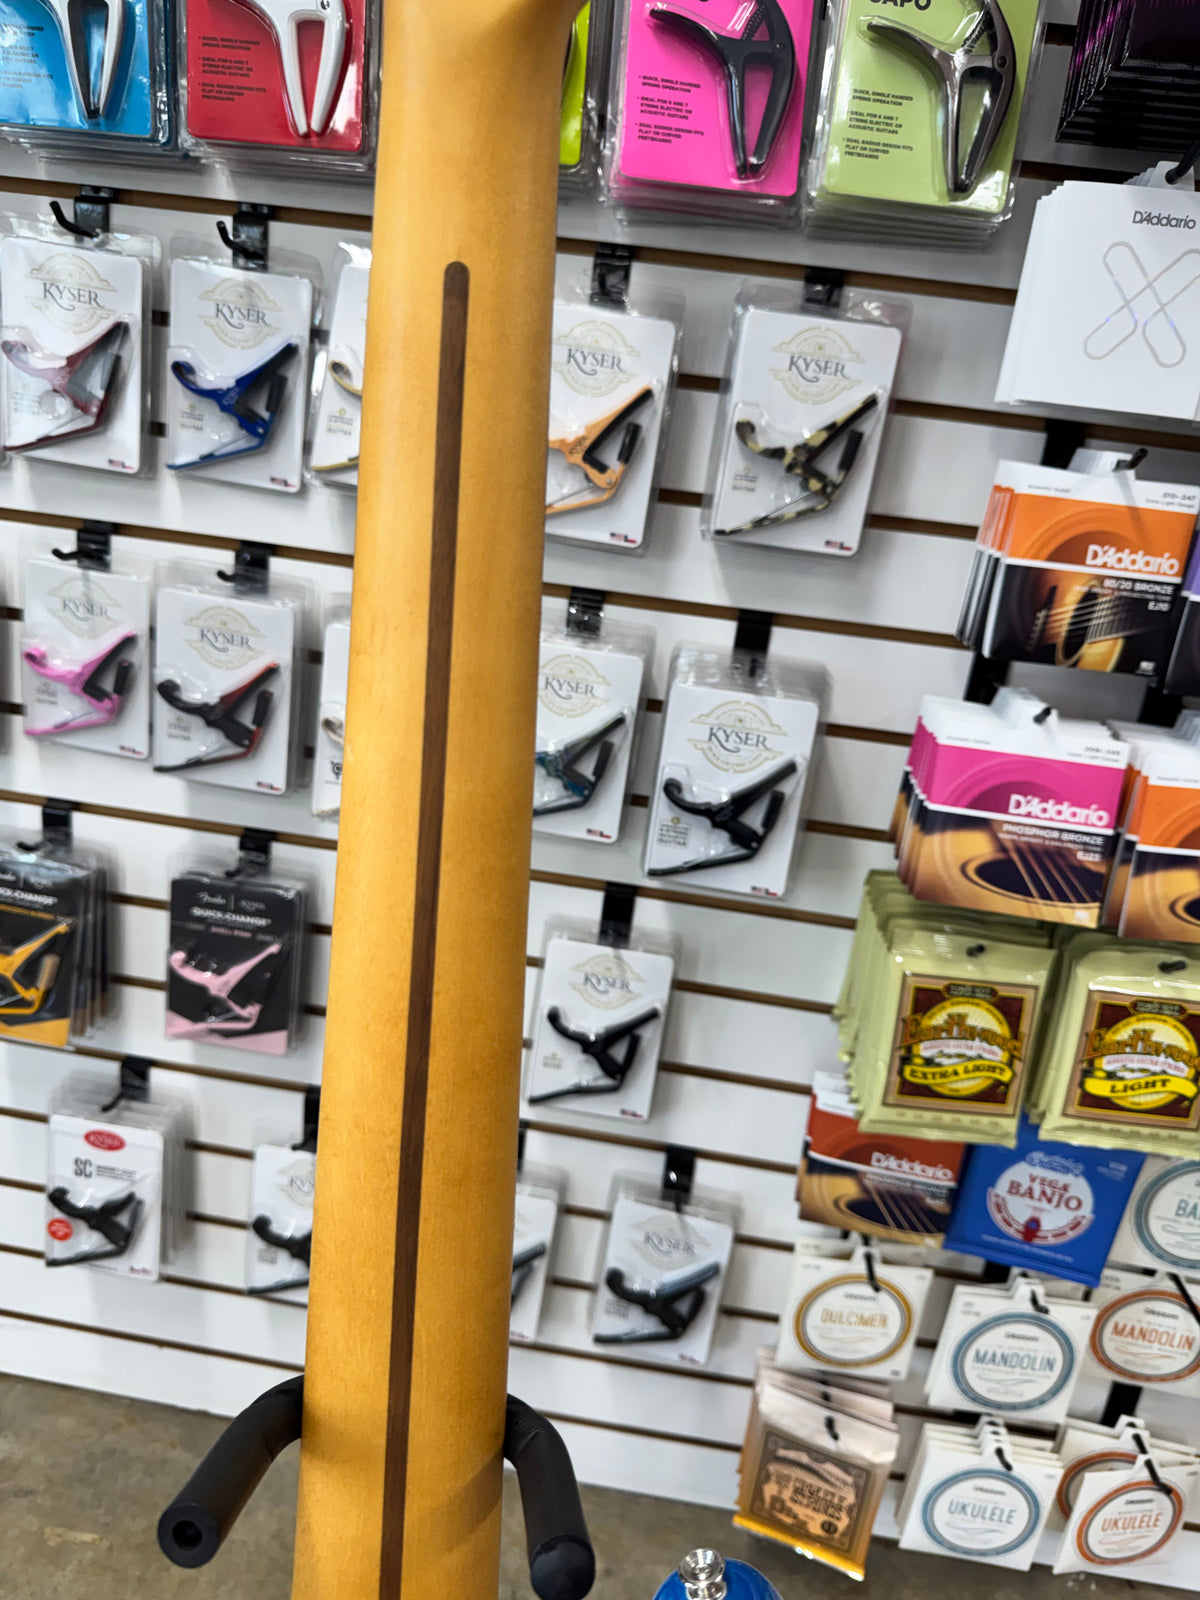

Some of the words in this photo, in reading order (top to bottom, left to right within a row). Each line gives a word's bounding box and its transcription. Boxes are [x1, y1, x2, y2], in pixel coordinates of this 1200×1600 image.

[1132, 210, 1196, 229] D'Addario
[42, 282, 104, 311] KYSER
[215, 303, 272, 329] KYSER
[567, 348, 627, 376] KYSER
[788, 355, 849, 383] KYSER
[1085, 543, 1180, 575] D'Addario
[1134, 581, 1175, 595] BRONZE
[62, 599, 114, 622] KYSER
[200, 629, 257, 653] KYSER
[544, 676, 597, 701] KYSER
[707, 726, 773, 753] KYSER
[1008, 793, 1110, 826] D'Addario
[1002, 823, 1060, 838] PHOSPHOR
[1061, 831, 1105, 845] BRONZE
[584, 973, 633, 994] KYSER
[909, 1067, 960, 1081] EXTRA
[963, 1063, 1007, 1076] LIGHT
[1109, 1078, 1171, 1094] LIGHT
[75, 1157, 92, 1178] SC
[870, 1151, 954, 1179] D'Addario
[1028, 1173, 1071, 1193] VEGA
[1007, 1180, 1083, 1211] BANJO
[1175, 1199, 1200, 1220] BA
[821, 1308, 889, 1329] DULCIMER
[1111, 1320, 1196, 1351] MANDOLIN
[972, 1348, 1057, 1373] MANDOLIN
[947, 1499, 1017, 1525] UKULELE
[1100, 1511, 1164, 1533] UKULELE
